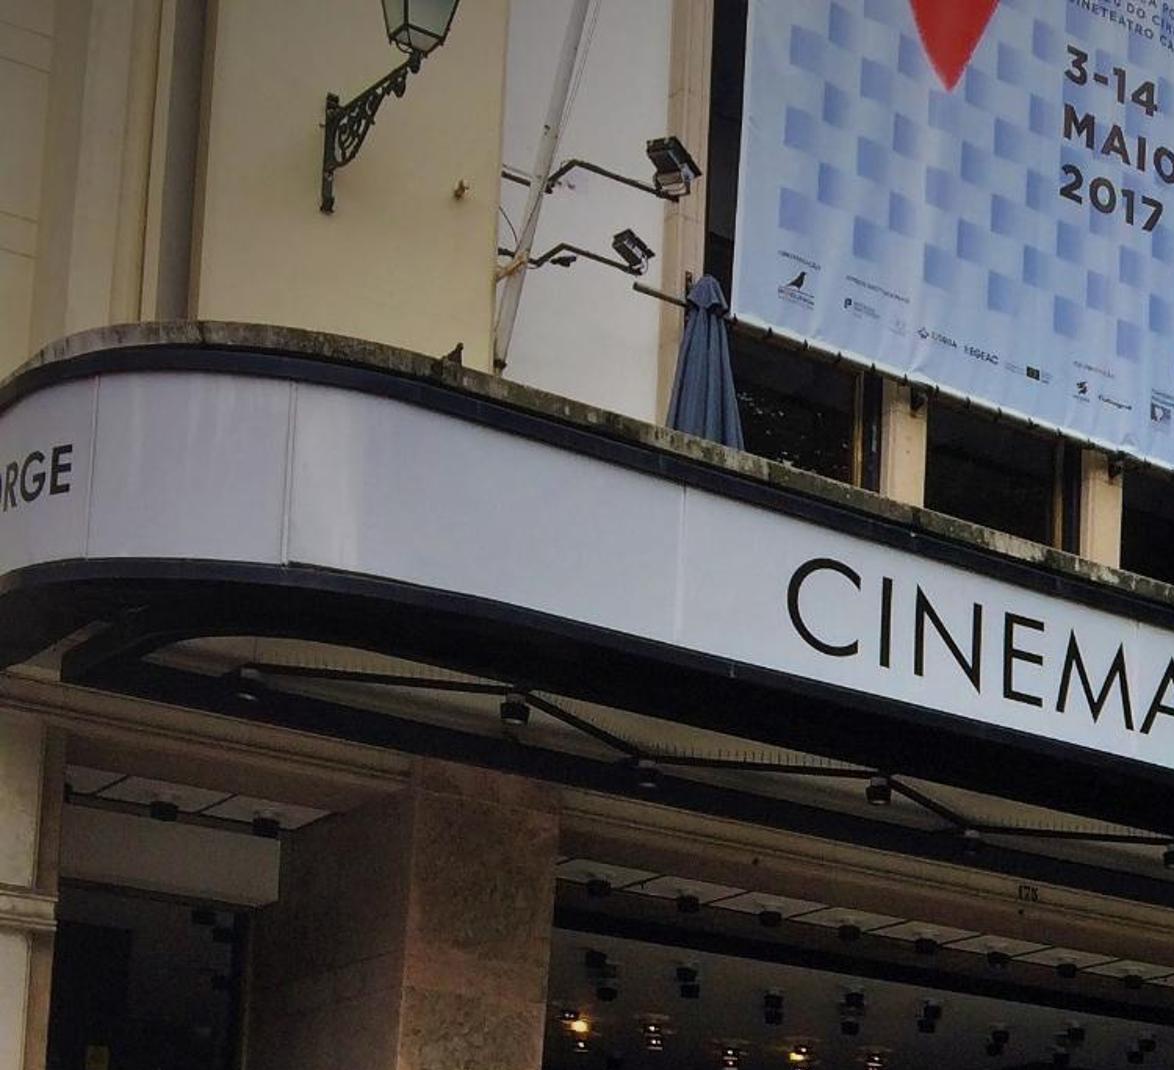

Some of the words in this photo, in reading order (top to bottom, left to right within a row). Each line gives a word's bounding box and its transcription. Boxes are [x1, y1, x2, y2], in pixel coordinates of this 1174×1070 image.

[1069, 0, 1154, 39] INETEATRO
[1126, 3, 1145, 19] DO
[1064, 44, 1157, 117] 3-14
[1059, 163, 1163, 232] 2017
[0, 444, 73, 512] RGE
